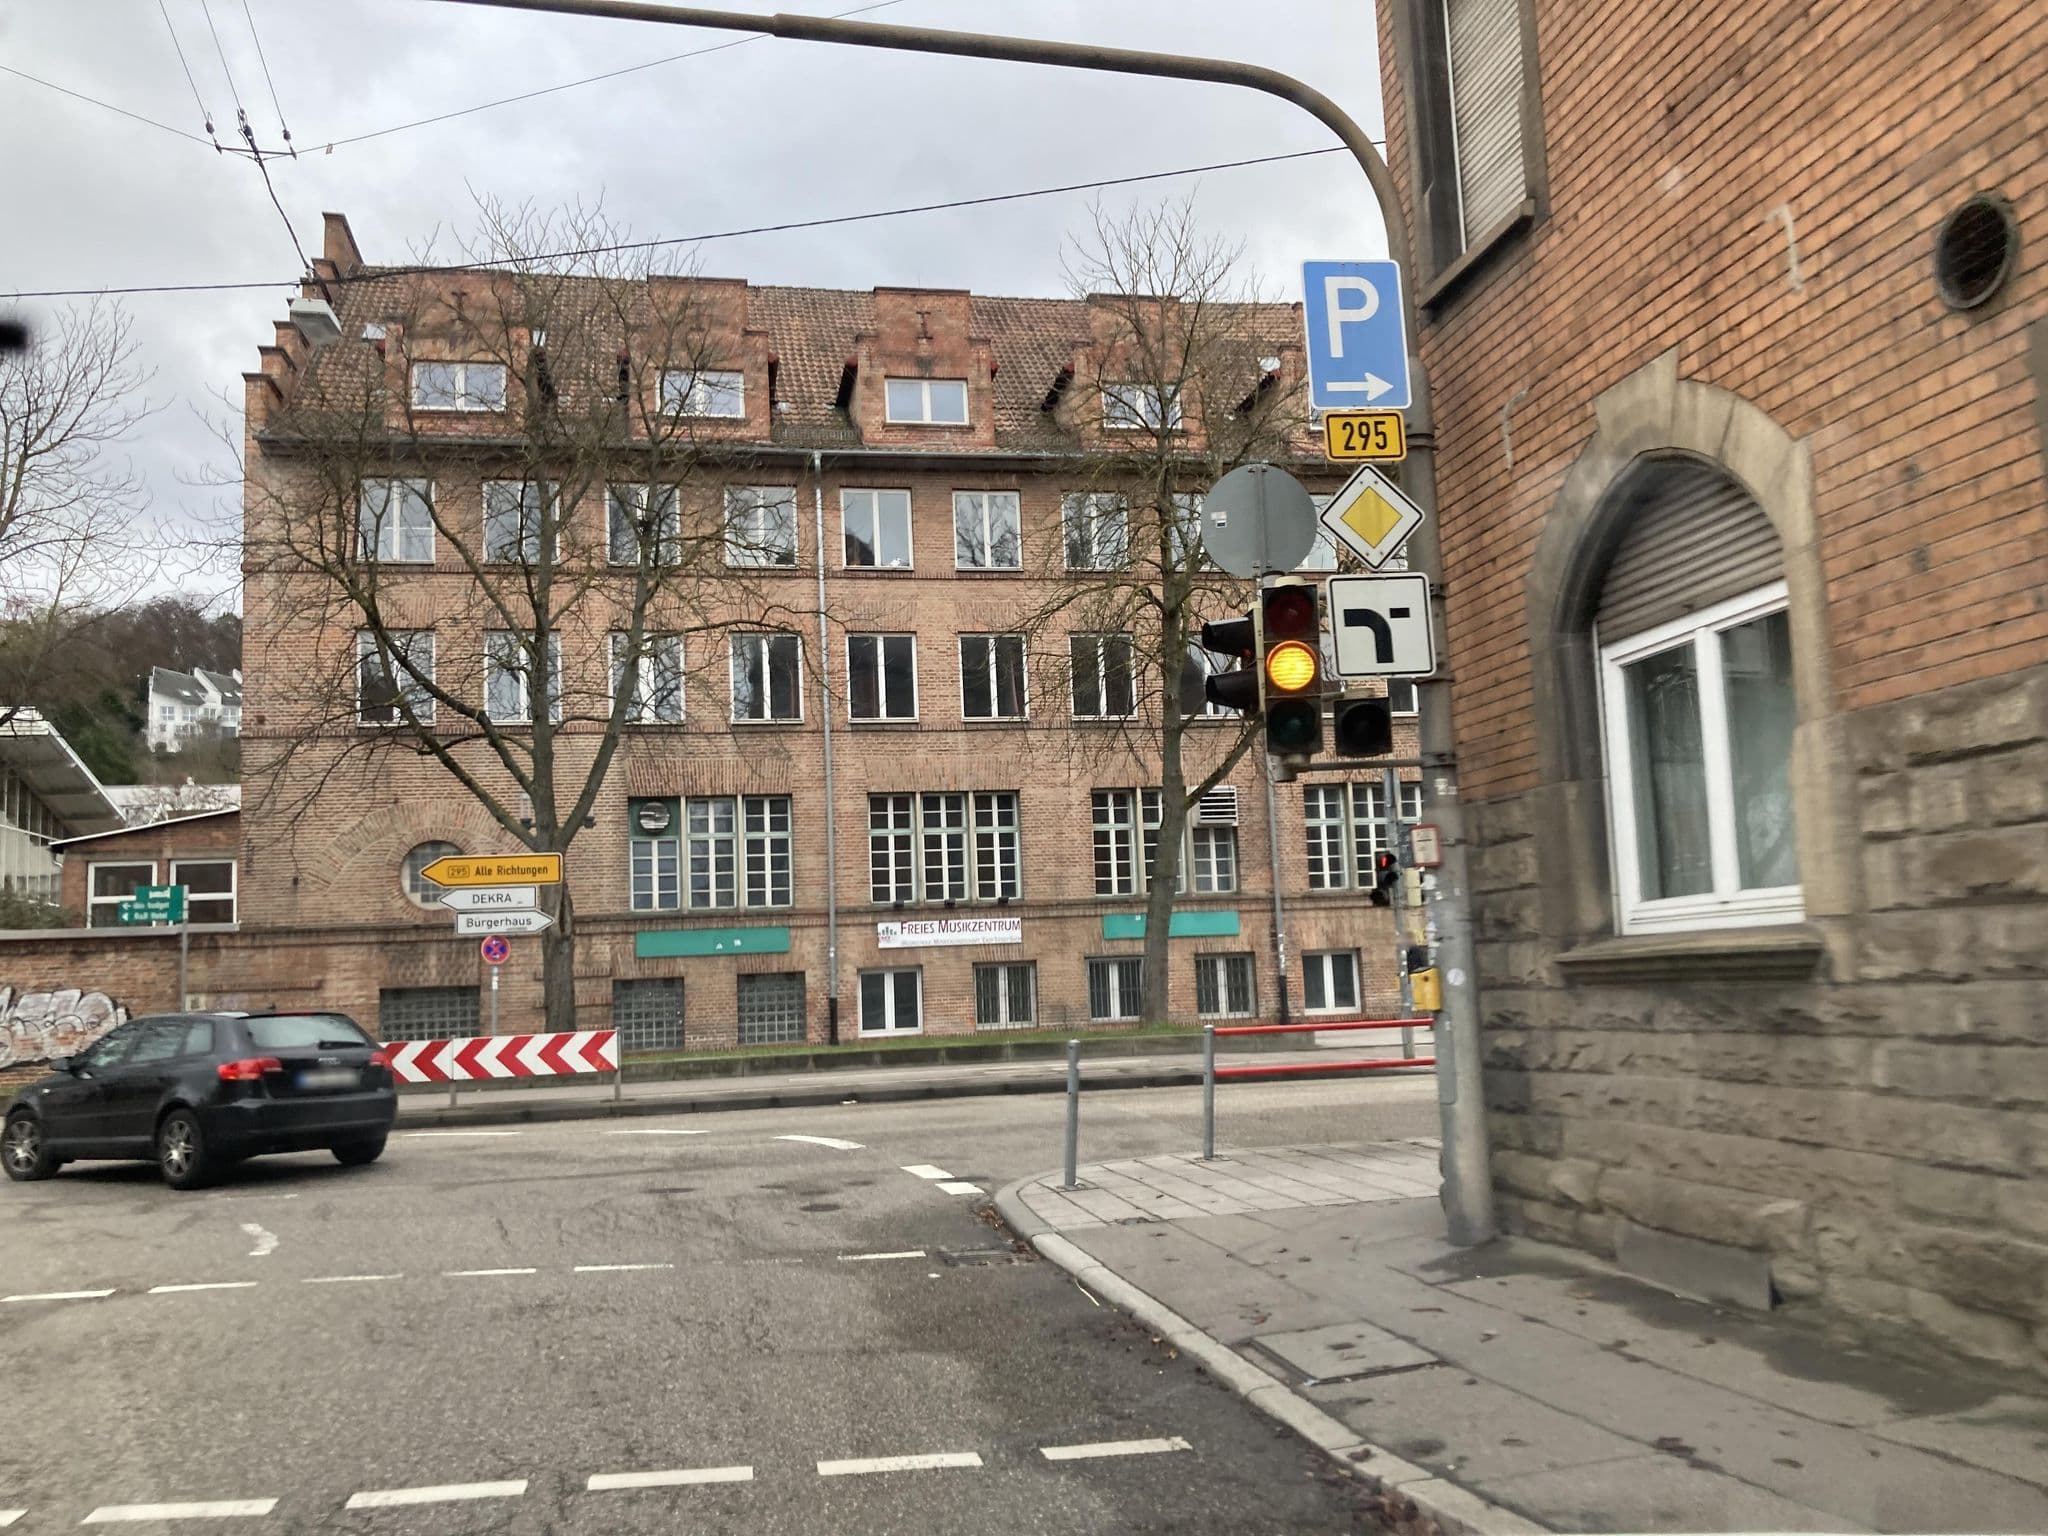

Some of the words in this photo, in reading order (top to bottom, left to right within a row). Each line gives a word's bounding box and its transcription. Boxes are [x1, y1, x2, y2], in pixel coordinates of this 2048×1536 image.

[1324, 276, 1380, 358] P
[1342, 420, 1388, 451] 295
[475, 866, 492, 876] Alle
[497, 865, 548, 877] Richtungen
[472, 893, 512, 904] DEKRA
[466, 917, 532, 929] Bürgerhaus
[900, 921, 935, 935] FREIES
[938, 919, 1021, 934] MUSIKZENTRUM
